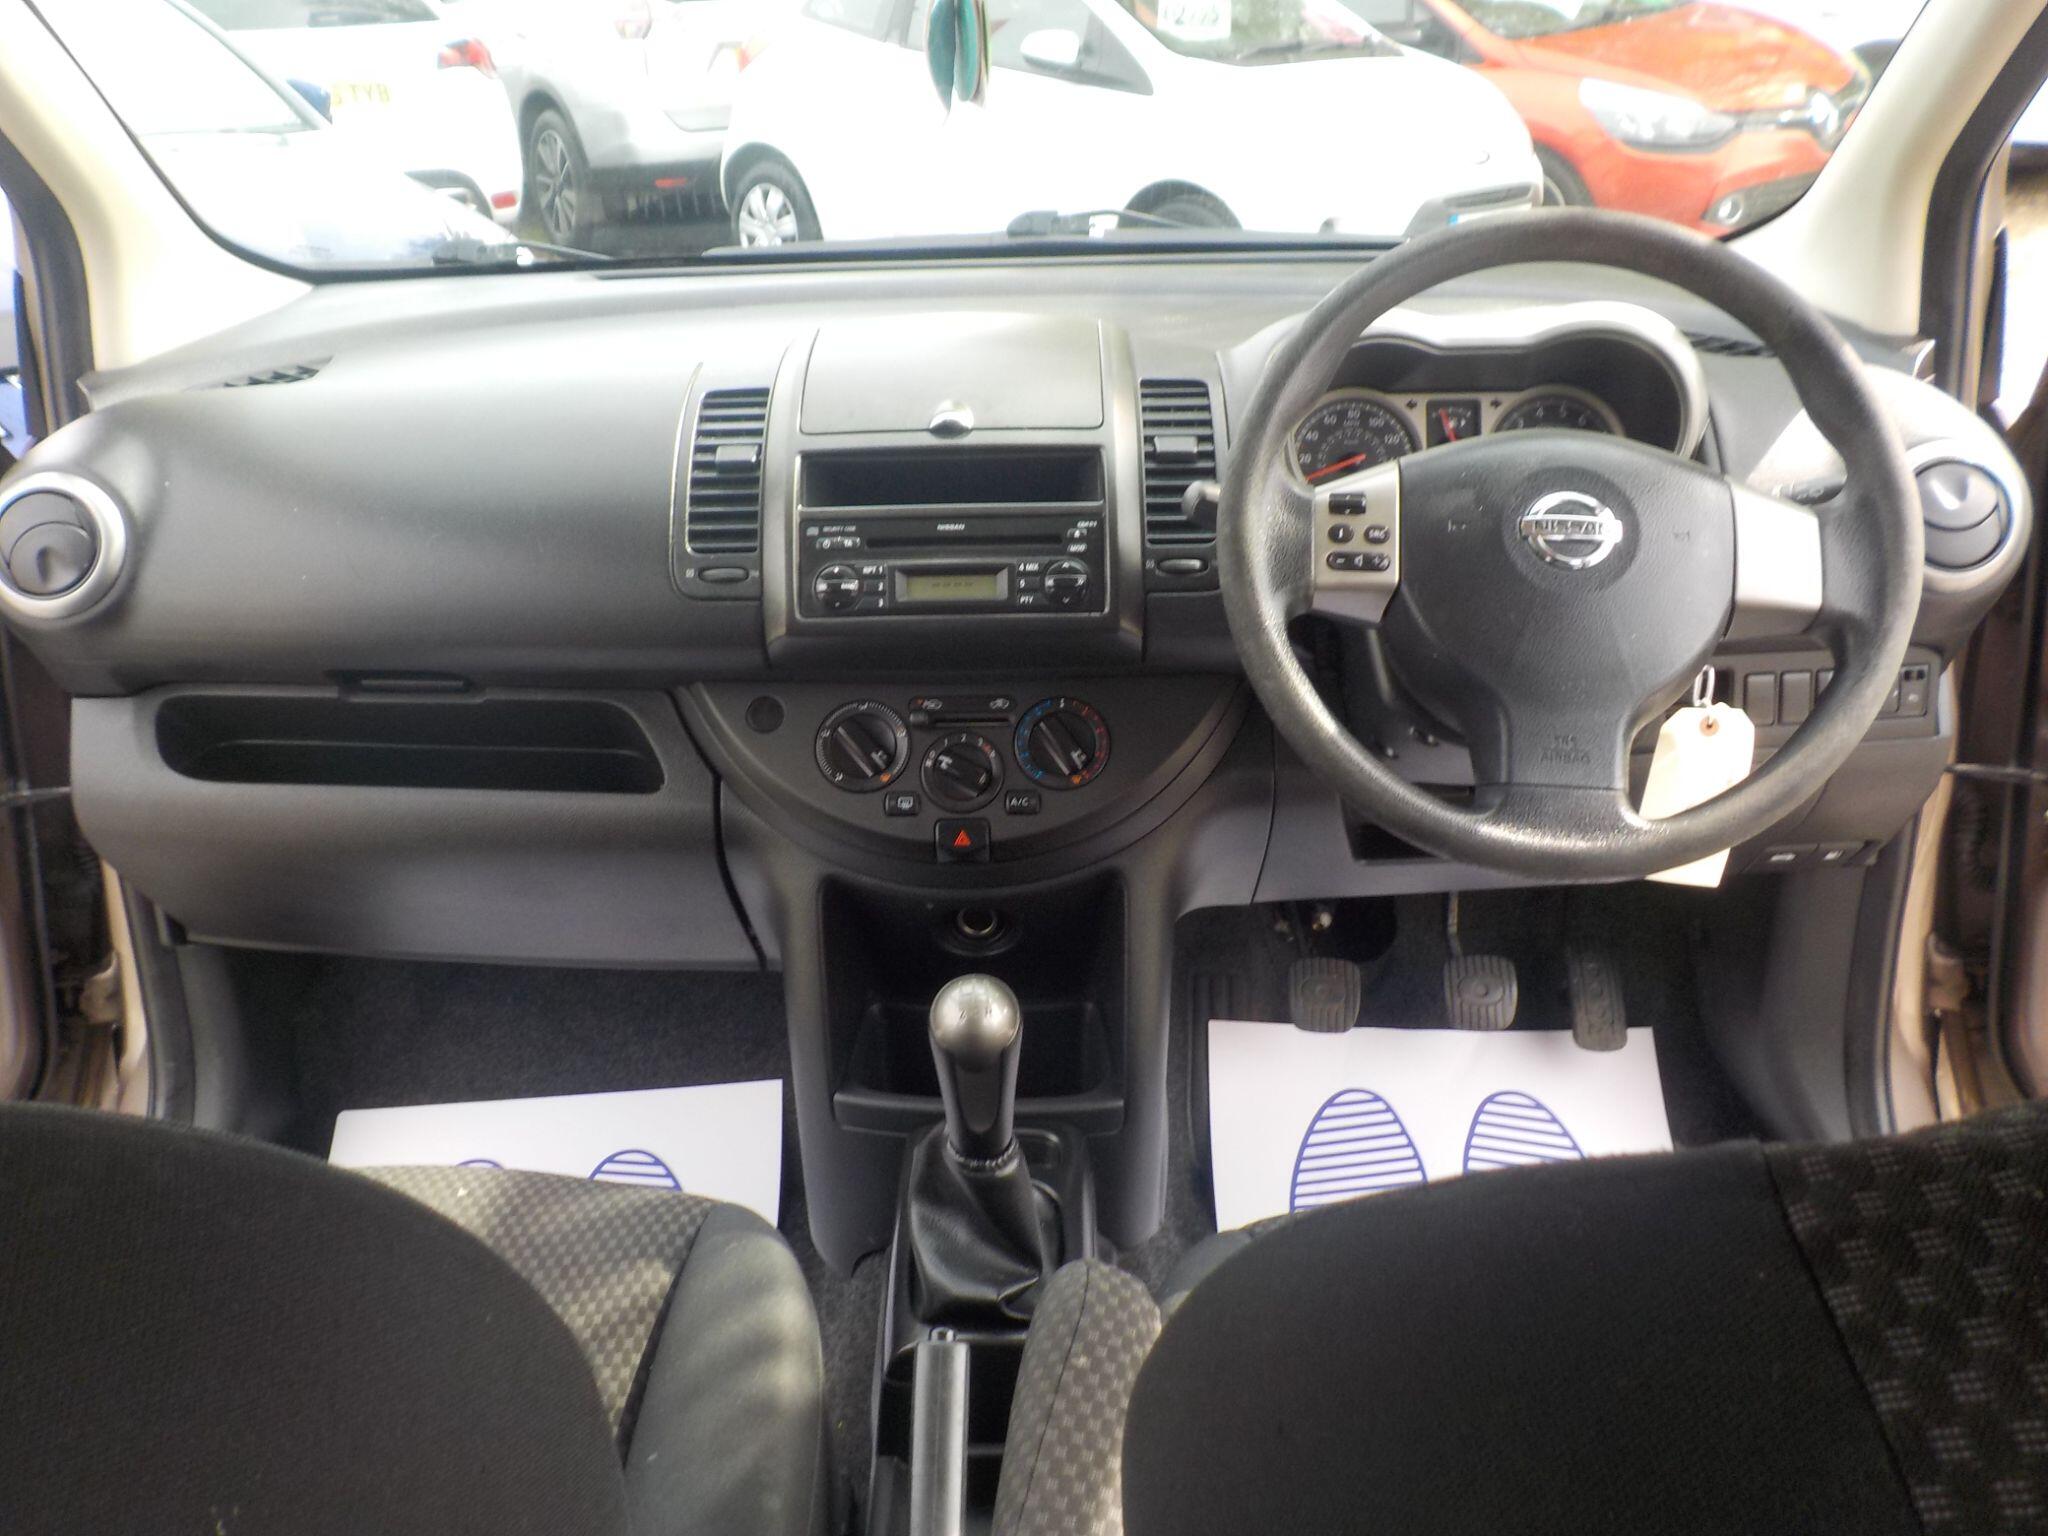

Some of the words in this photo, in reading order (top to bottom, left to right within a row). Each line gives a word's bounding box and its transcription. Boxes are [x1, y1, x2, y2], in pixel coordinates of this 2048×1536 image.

[1347, 409, 1360, 419] 80
[1323, 415, 1337, 425] 60
[1368, 417, 1385, 427] 100
[1305, 430, 1319, 441] 40
[1384, 433, 1401, 444] 120
[1299, 453, 1311, 464] 20
[1010, 796, 1029, 807] A/C
